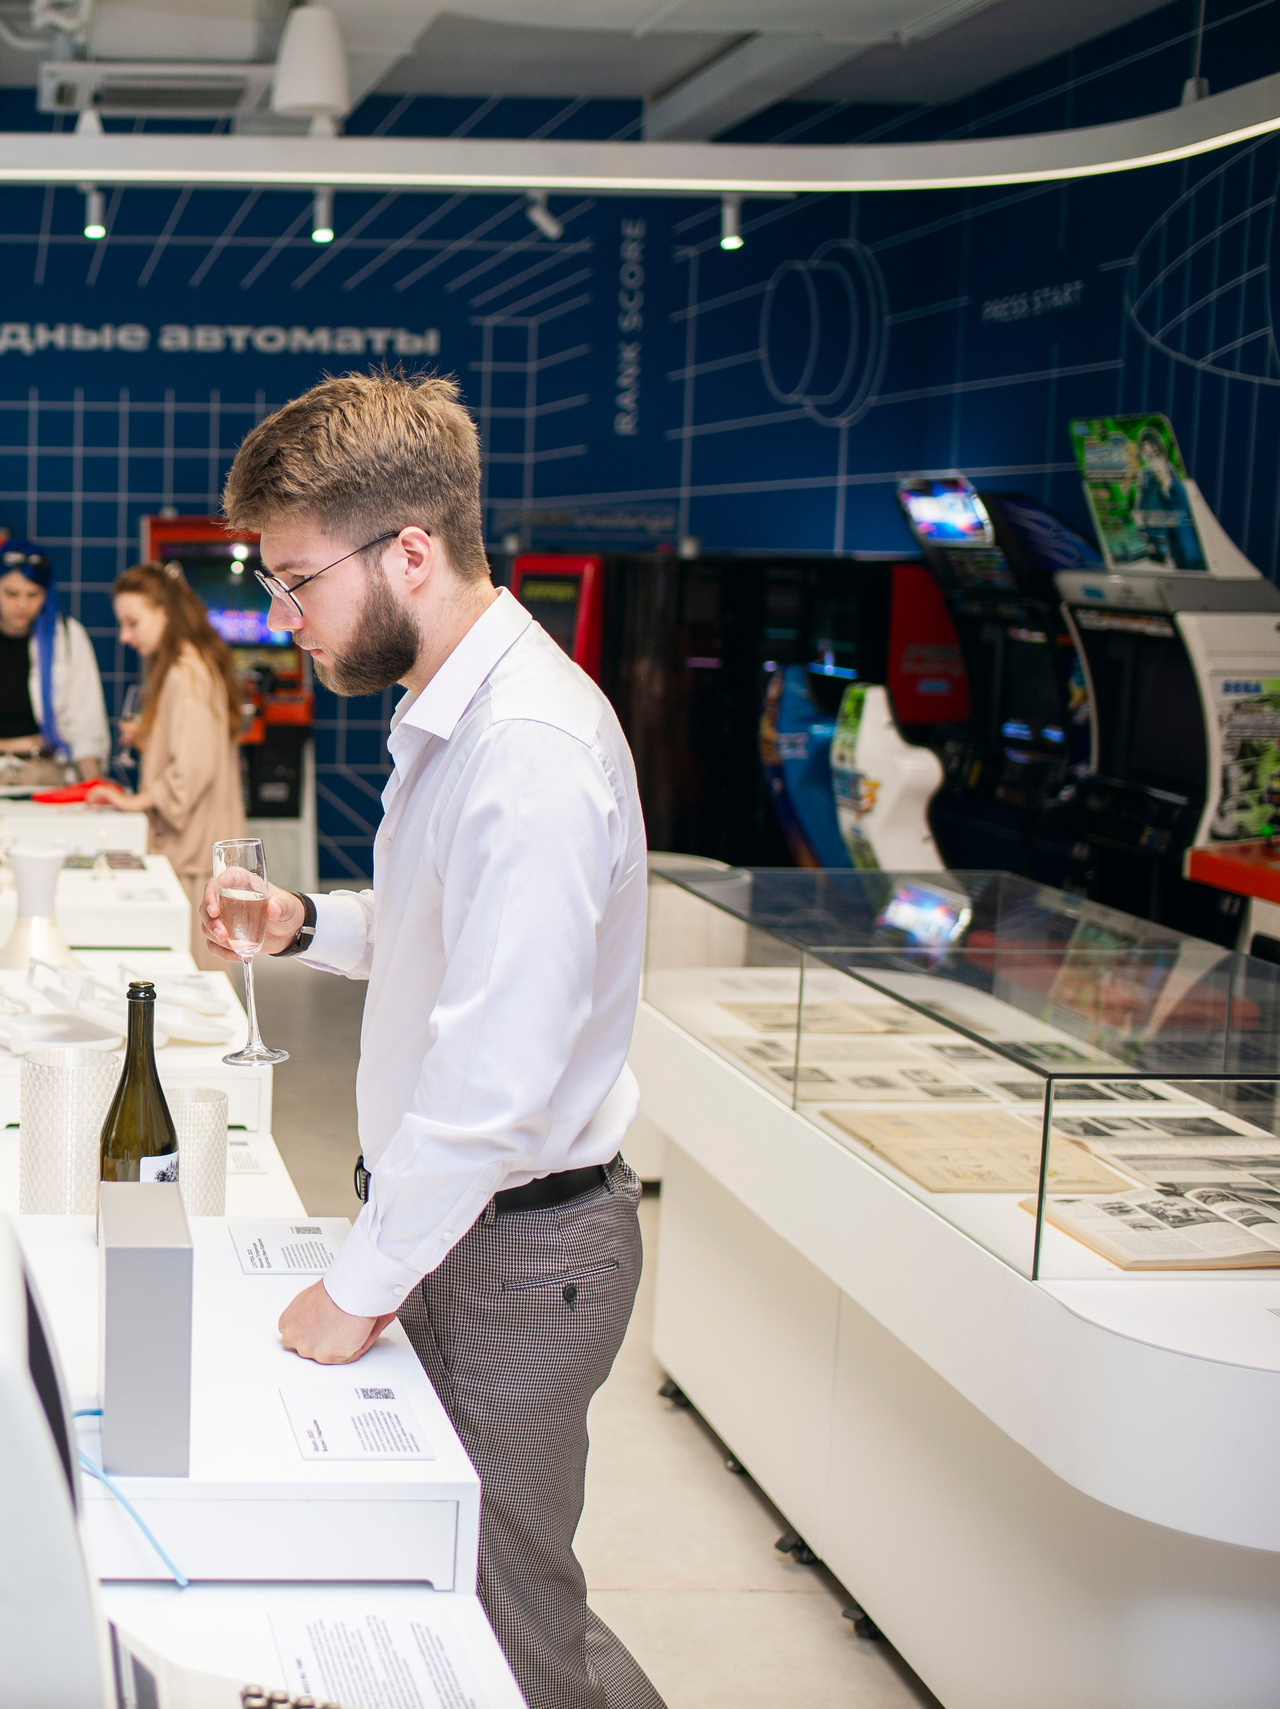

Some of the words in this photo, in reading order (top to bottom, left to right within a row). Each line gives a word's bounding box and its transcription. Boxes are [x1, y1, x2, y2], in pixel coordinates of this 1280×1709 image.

[619, 218, 646, 332] SCORE
[983, 293, 1028, 321] PRESS
[1032, 280, 1083, 315] START
[158, 323, 440, 355] автоматы
[614, 341, 642, 435] RANK
[1222, 680, 1263, 694] SEGA
